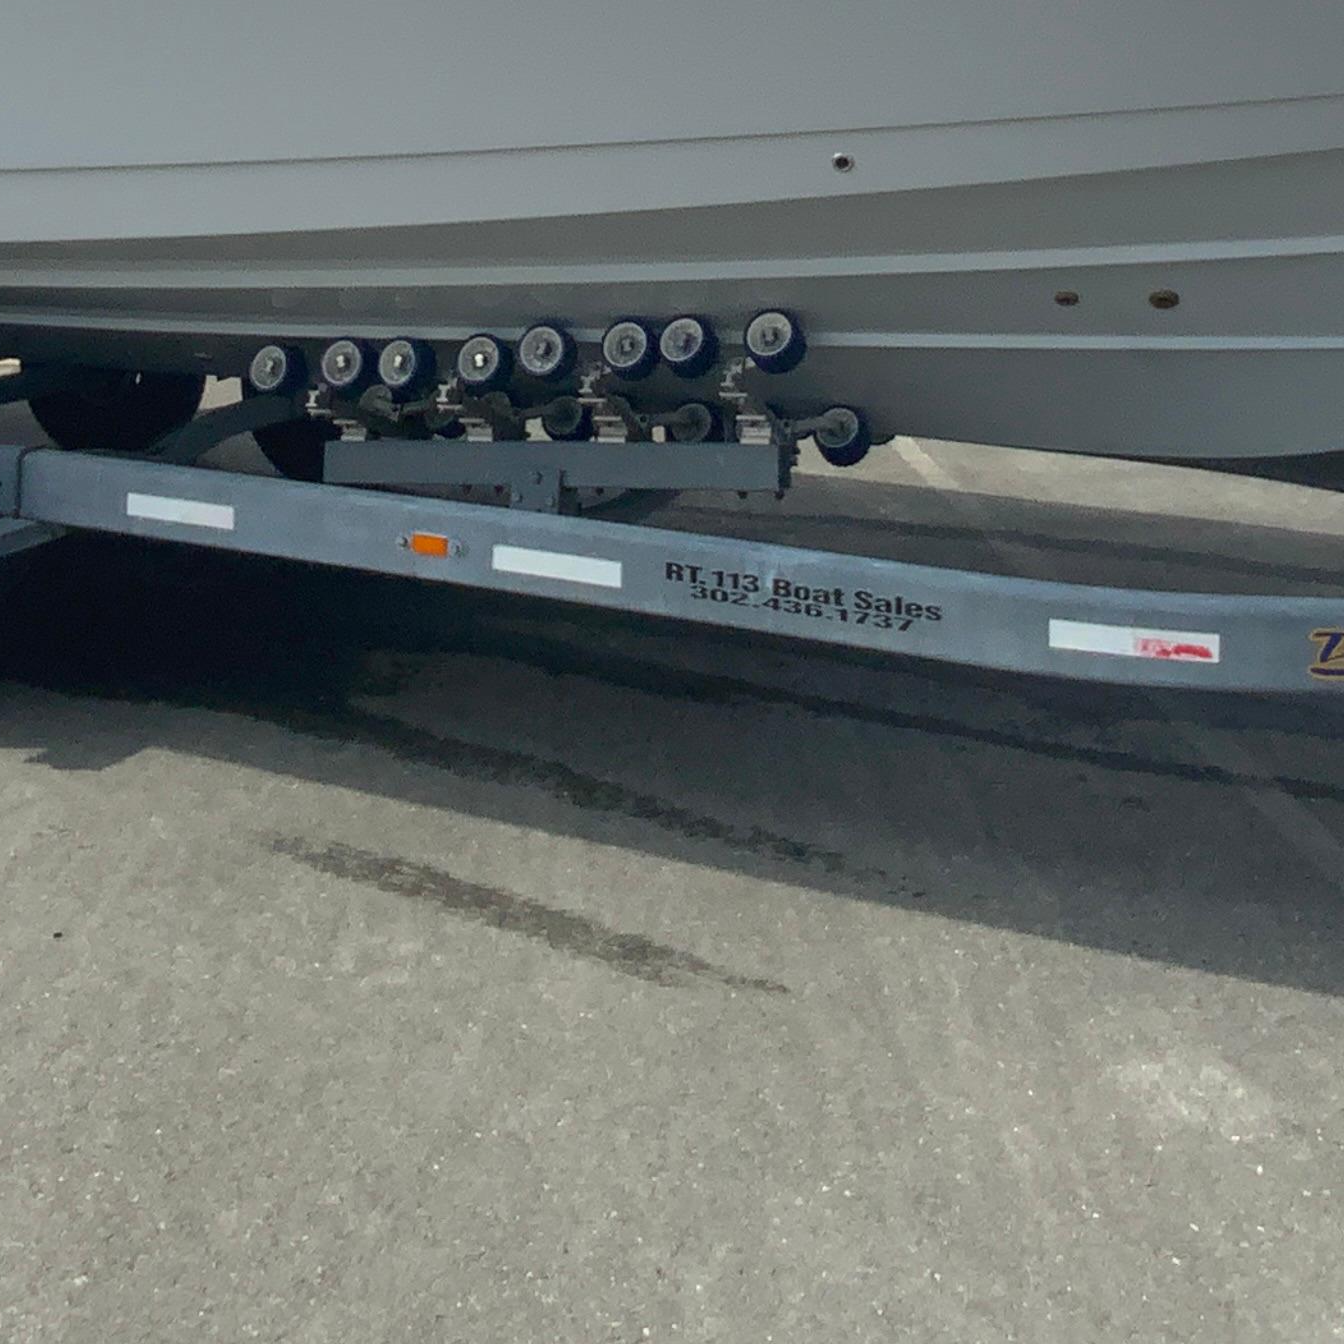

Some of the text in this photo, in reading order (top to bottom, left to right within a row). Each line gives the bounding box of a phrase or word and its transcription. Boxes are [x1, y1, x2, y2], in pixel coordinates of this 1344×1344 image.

[689, 584, 914, 632] 302.436.1737
[772, 578, 845, 607] Boat
[854, 590, 943, 622] Sales
